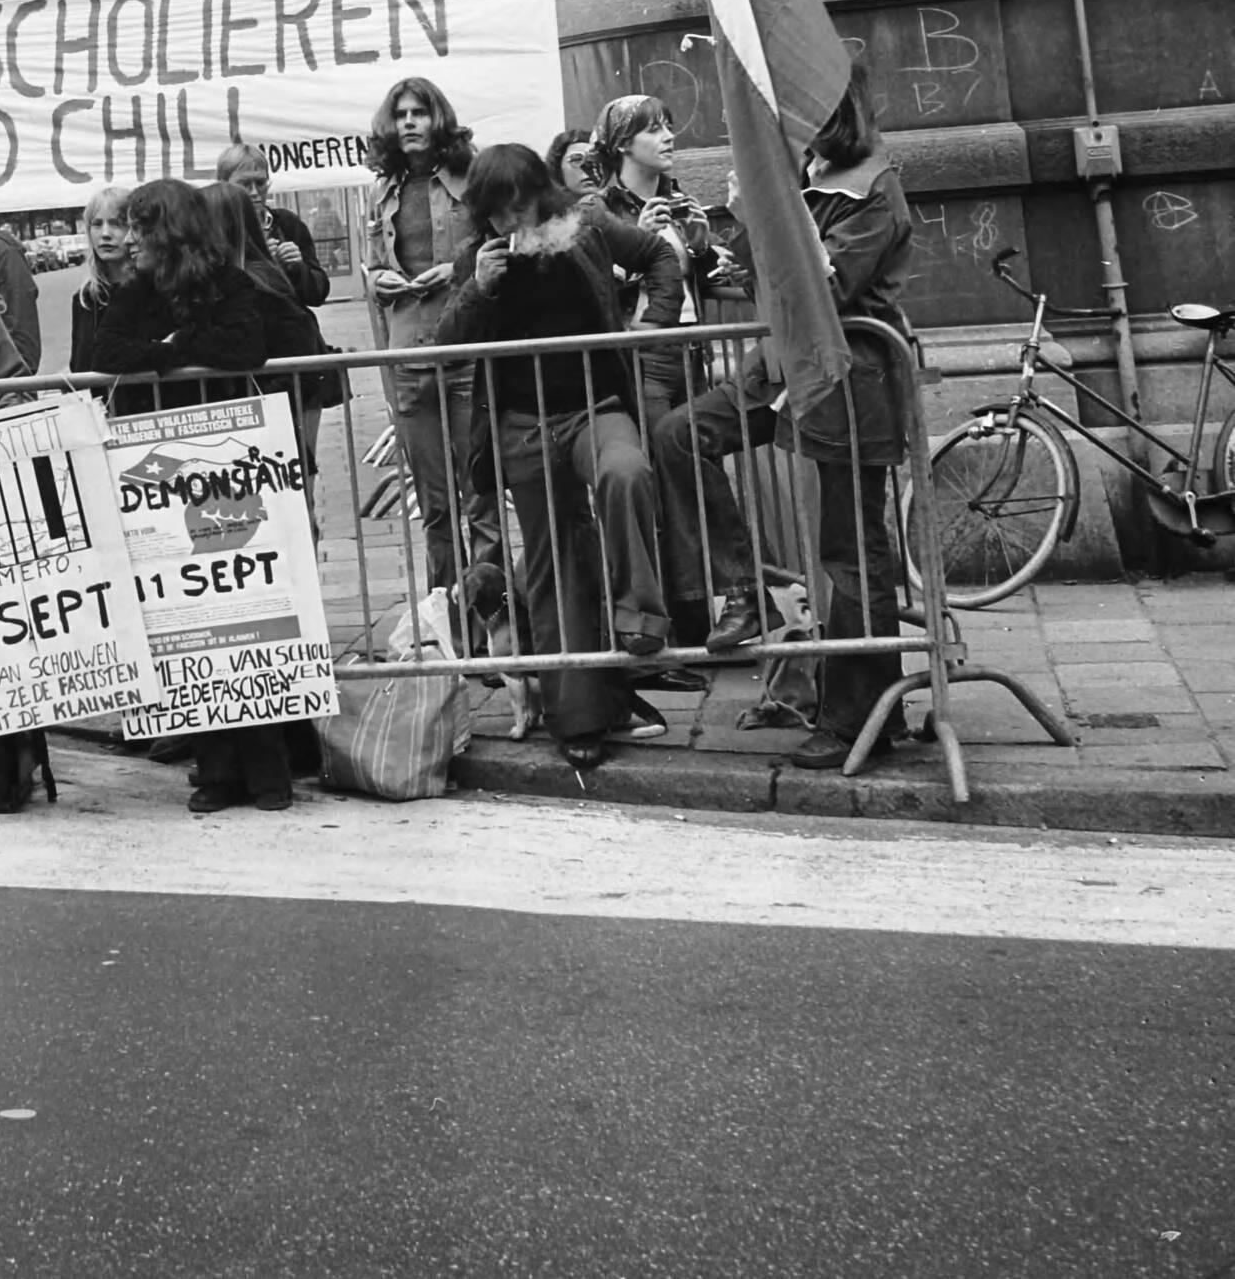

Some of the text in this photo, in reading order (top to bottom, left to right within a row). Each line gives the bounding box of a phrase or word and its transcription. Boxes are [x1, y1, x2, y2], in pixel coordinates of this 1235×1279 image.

[51, 87, 240, 184] CHILI
[258, 135, 370, 173] ONGEREN
[134, 551, 279, 602] 11 SEPT
[28, 640, 118, 679] SCHOUWEN
[153, 655, 213, 687] MERO
[230, 647, 273, 674] VAN
[6, 686, 31, 709] ZE
[32, 680, 53, 704] DE
[57, 661, 139, 696] FASCISTEN
[213, 673, 291, 703] FASCISTEN
[17, 706, 44, 729] DE
[52, 688, 143, 721] KLAUWEN
[126, 712, 167, 736] UIT
[166, 710, 201, 731] DE
